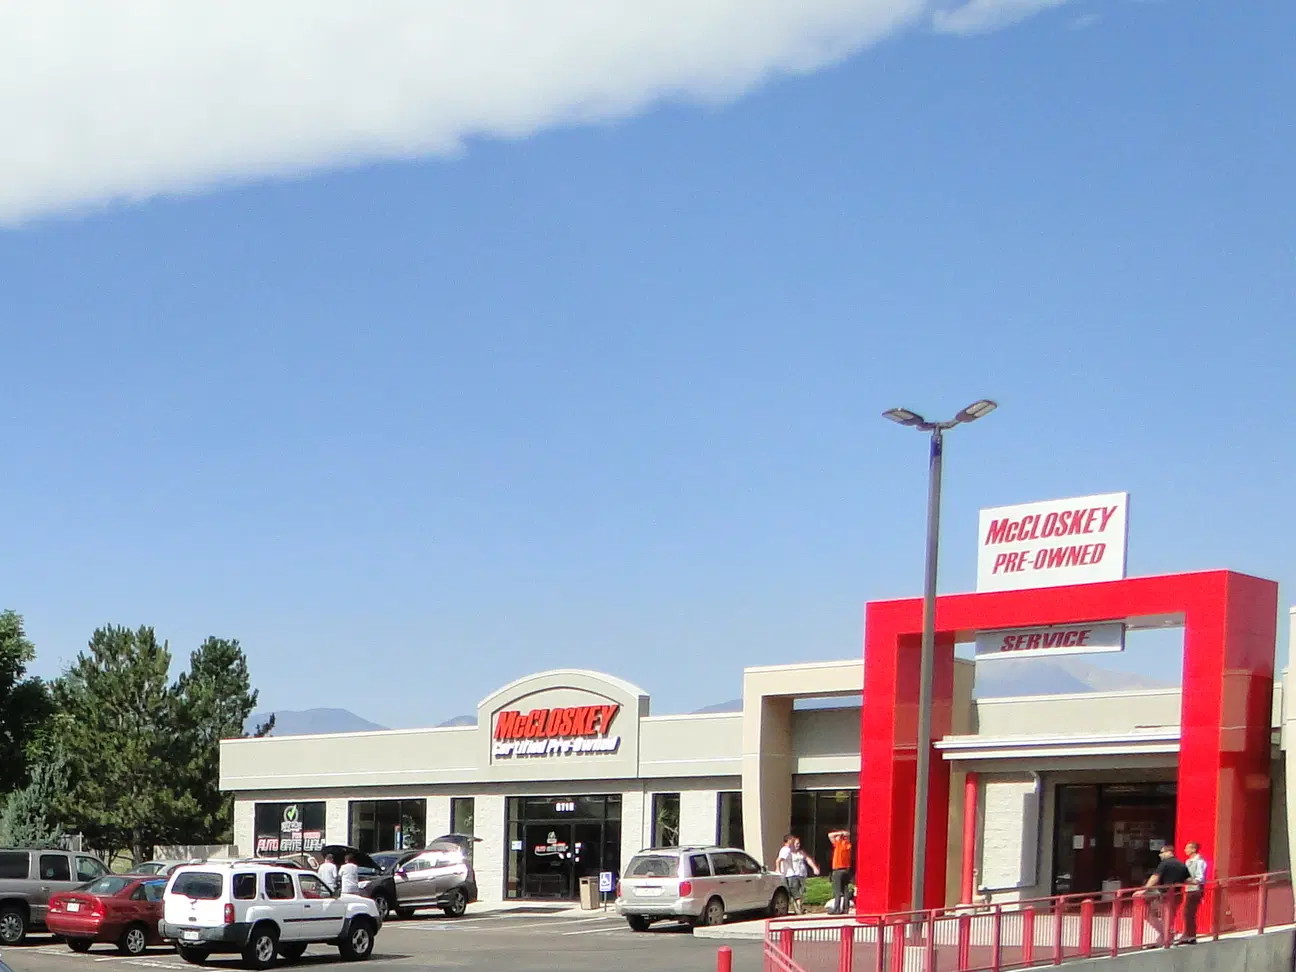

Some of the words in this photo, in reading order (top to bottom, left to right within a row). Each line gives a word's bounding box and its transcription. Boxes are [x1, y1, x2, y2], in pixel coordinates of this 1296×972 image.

[985, 506, 1118, 546] McCLOSKEY
[992, 543, 1106, 575] PRE-OWNED
[1000, 629, 1092, 652] SERVICE
[494, 704, 620, 741] McCLOSKEY
[257, 838, 280, 852] AUTO
